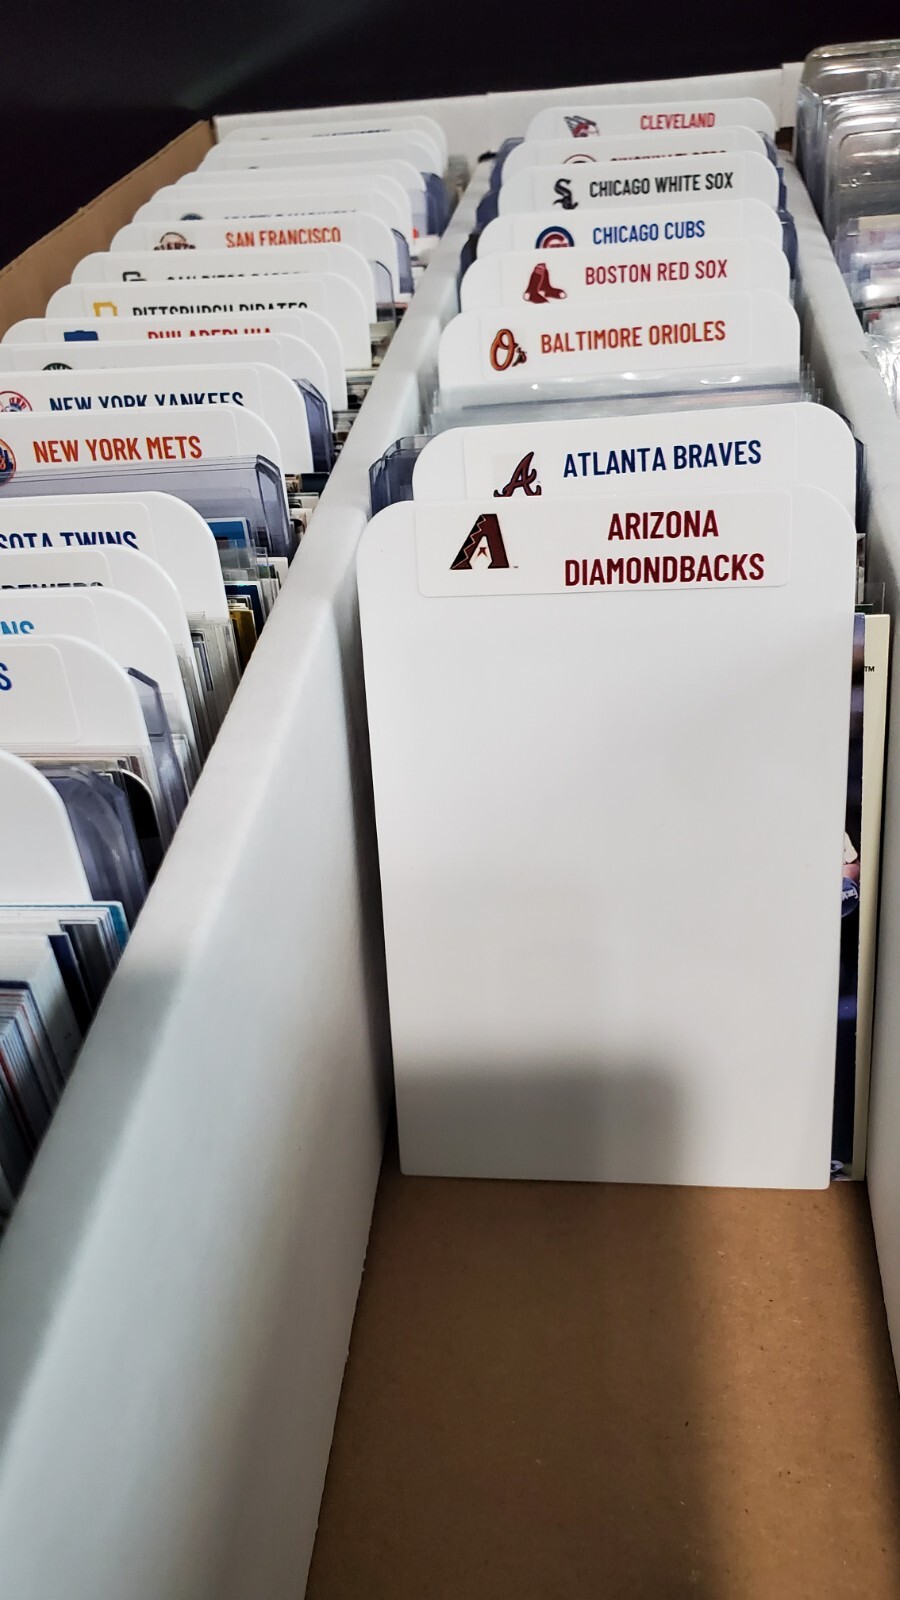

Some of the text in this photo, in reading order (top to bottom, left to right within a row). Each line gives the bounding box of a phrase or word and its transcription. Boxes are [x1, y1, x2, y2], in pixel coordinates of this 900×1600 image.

[640, 112, 716, 131] CLEVELAND
[589, 171, 734, 198] CHICAGO WHITE SOX
[225, 226, 342, 249] SAN FRANCISCO
[592, 222, 660, 245] CHICAGO
[664, 219, 706, 240] CUBS
[585, 258, 728, 286] BOSTON RED SOX
[540, 319, 726, 355] BALTIMORE ORIOLES
[32, 440, 79, 464] NEW
[84, 437, 143, 462] YORK
[145, 435, 203, 460] METS
[562, 439, 762, 479] ATLANTA BRAVES
[607, 509, 720, 542] ARIZONA
[564, 552, 765, 587] DIAMONDBACKS
